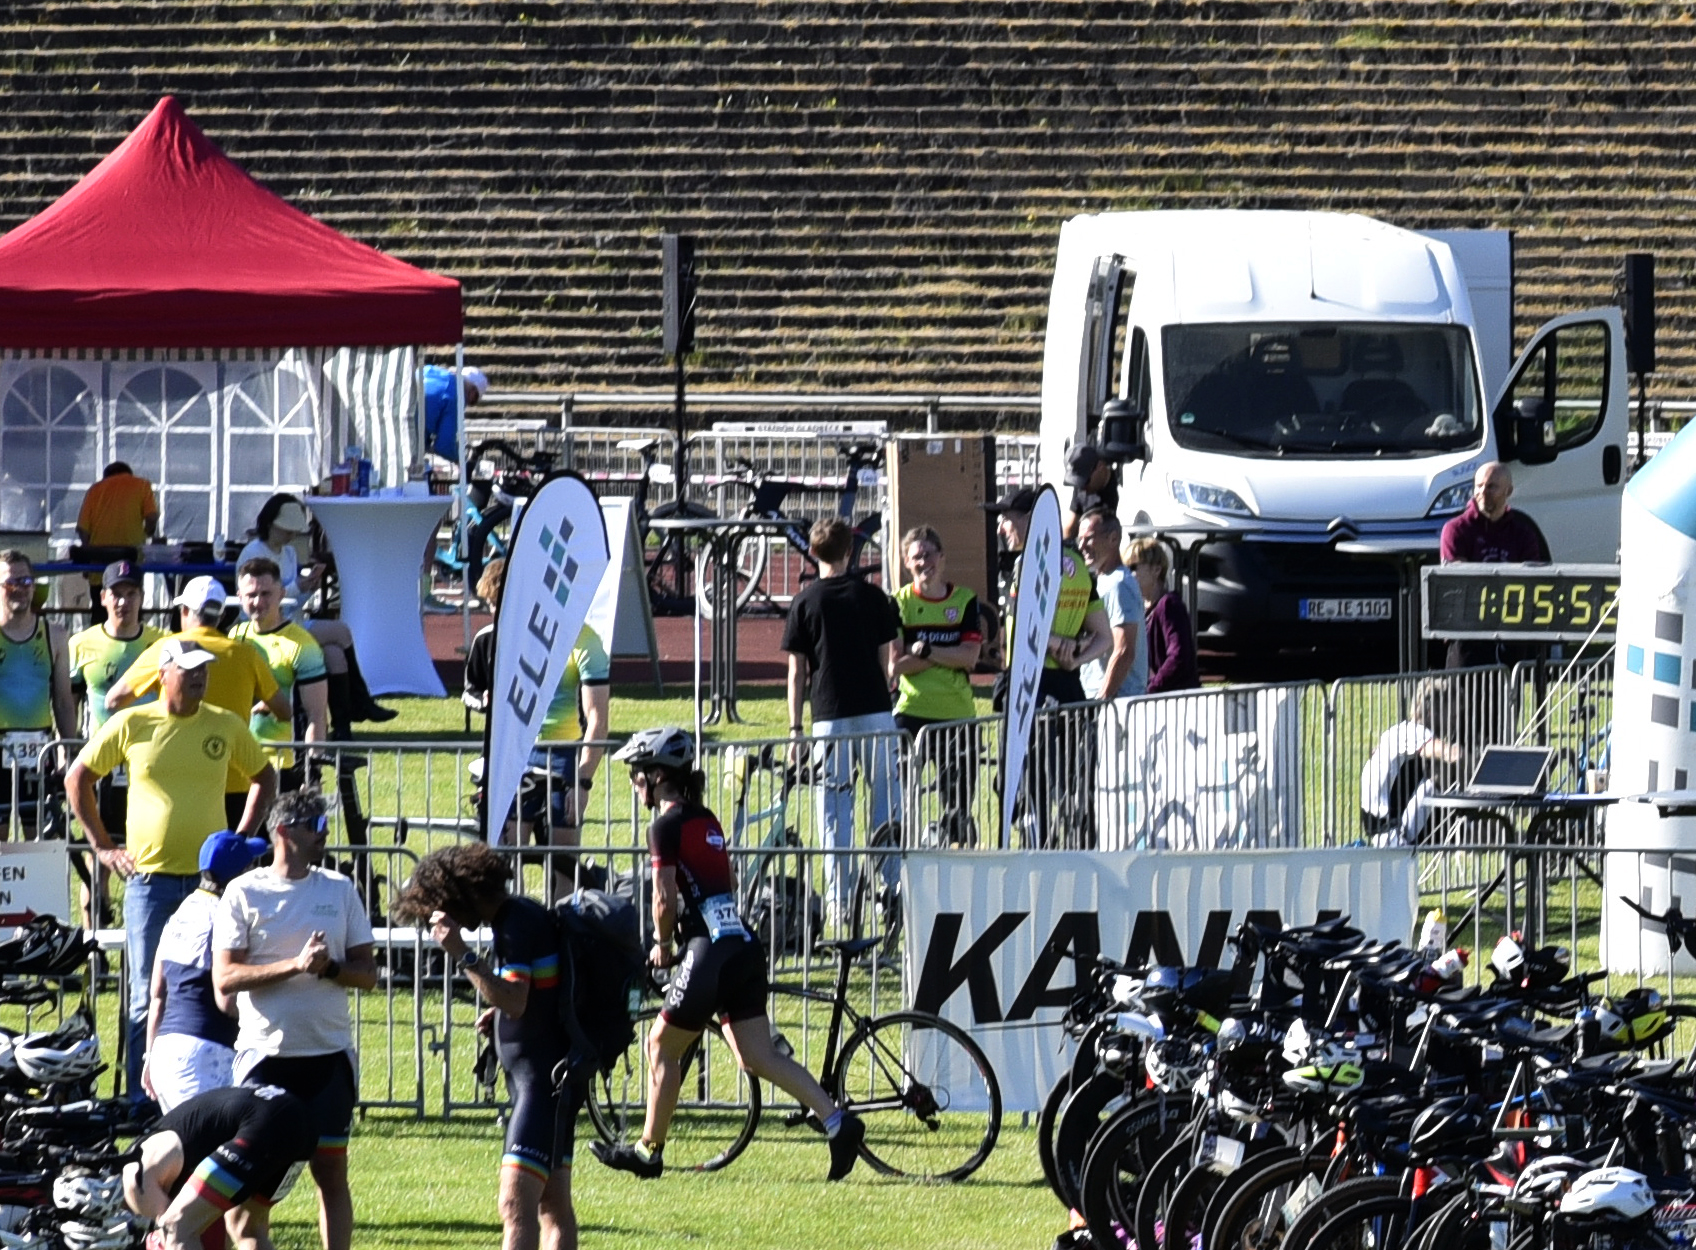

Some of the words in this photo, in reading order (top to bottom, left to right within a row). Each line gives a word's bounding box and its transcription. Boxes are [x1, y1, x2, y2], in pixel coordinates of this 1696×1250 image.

[1307, 601, 1325, 616] RE
[1336, 601, 1352, 616] IE
[1357, 600, 1391, 617] 1101
[507, 601, 559, 726] ELE
